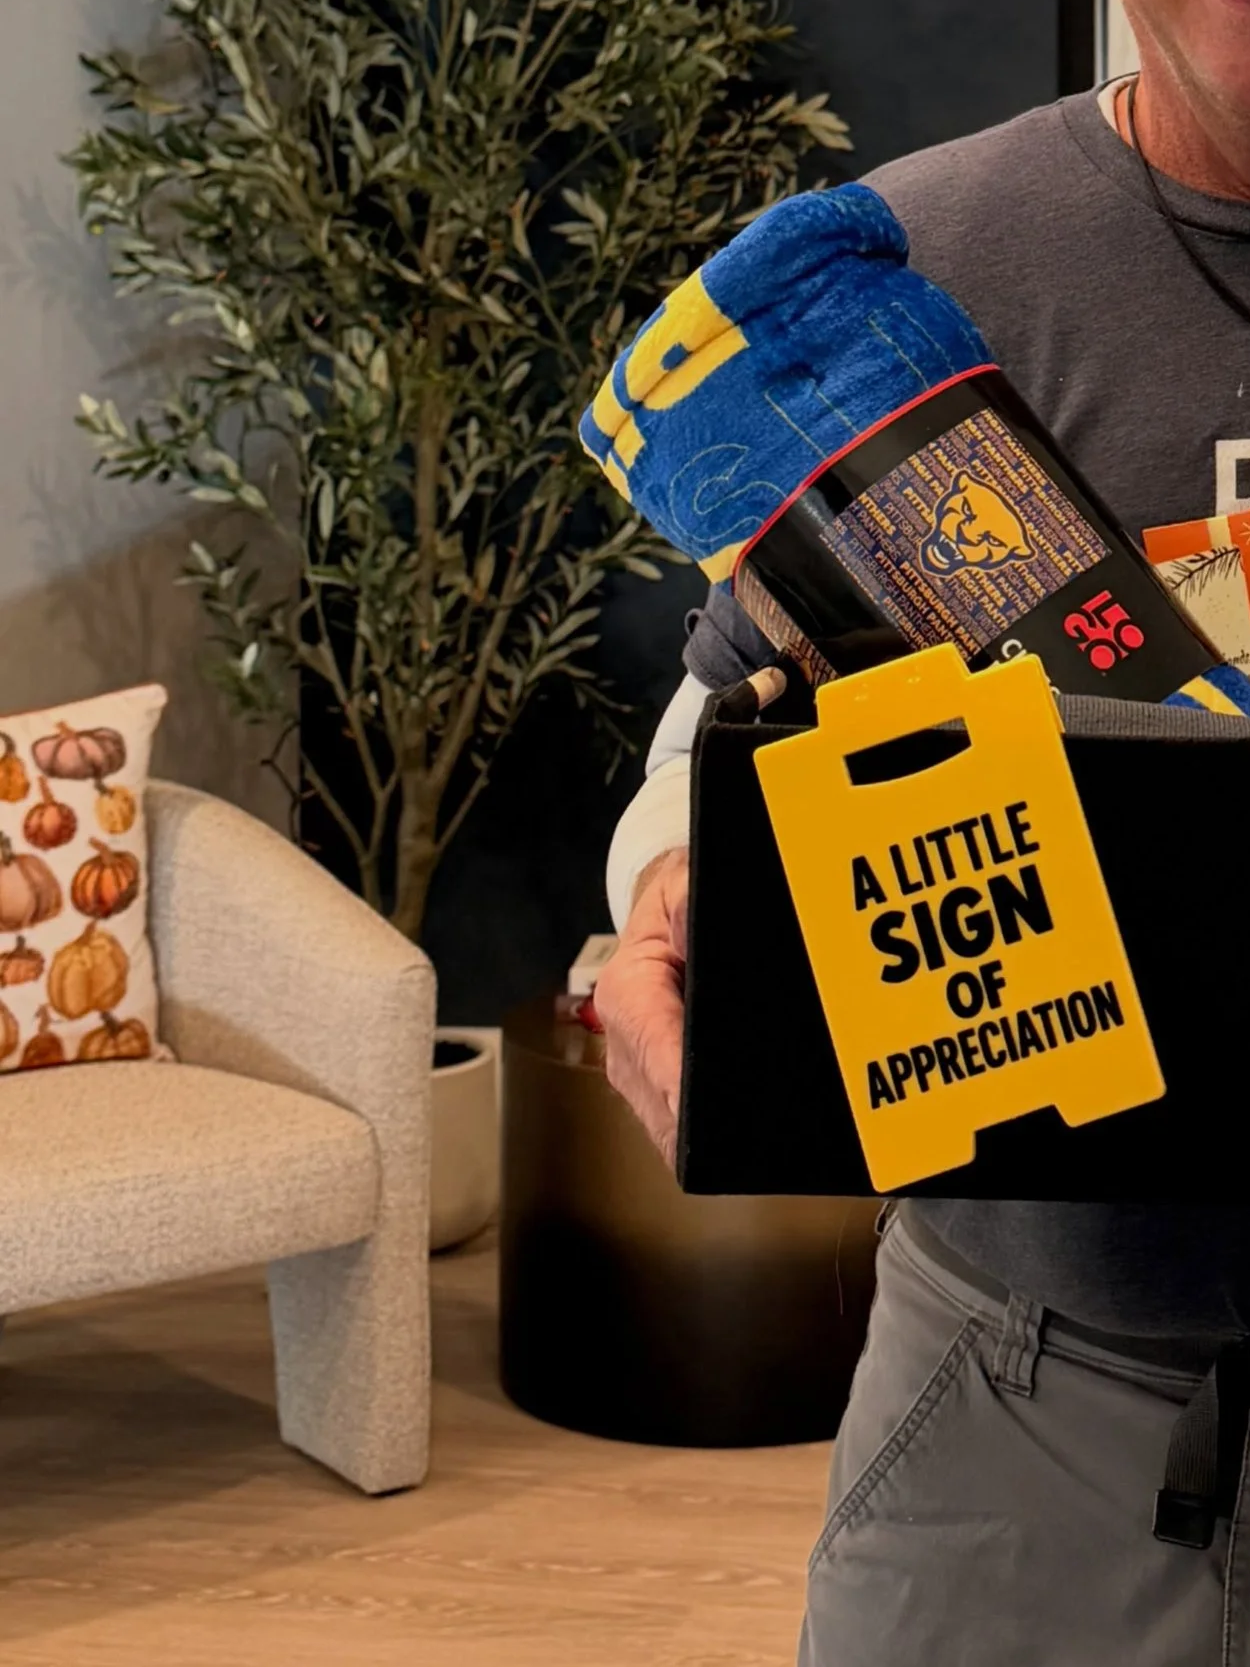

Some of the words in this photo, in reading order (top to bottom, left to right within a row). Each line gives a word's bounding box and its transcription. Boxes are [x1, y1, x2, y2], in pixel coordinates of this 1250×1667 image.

[851, 855, 887, 911] A
[889, 800, 1040, 896] LITTLE
[869, 864, 1055, 985] SIGN
[866, 981, 1125, 1110] APPRECIATION
[945, 959, 1008, 1020] OF
